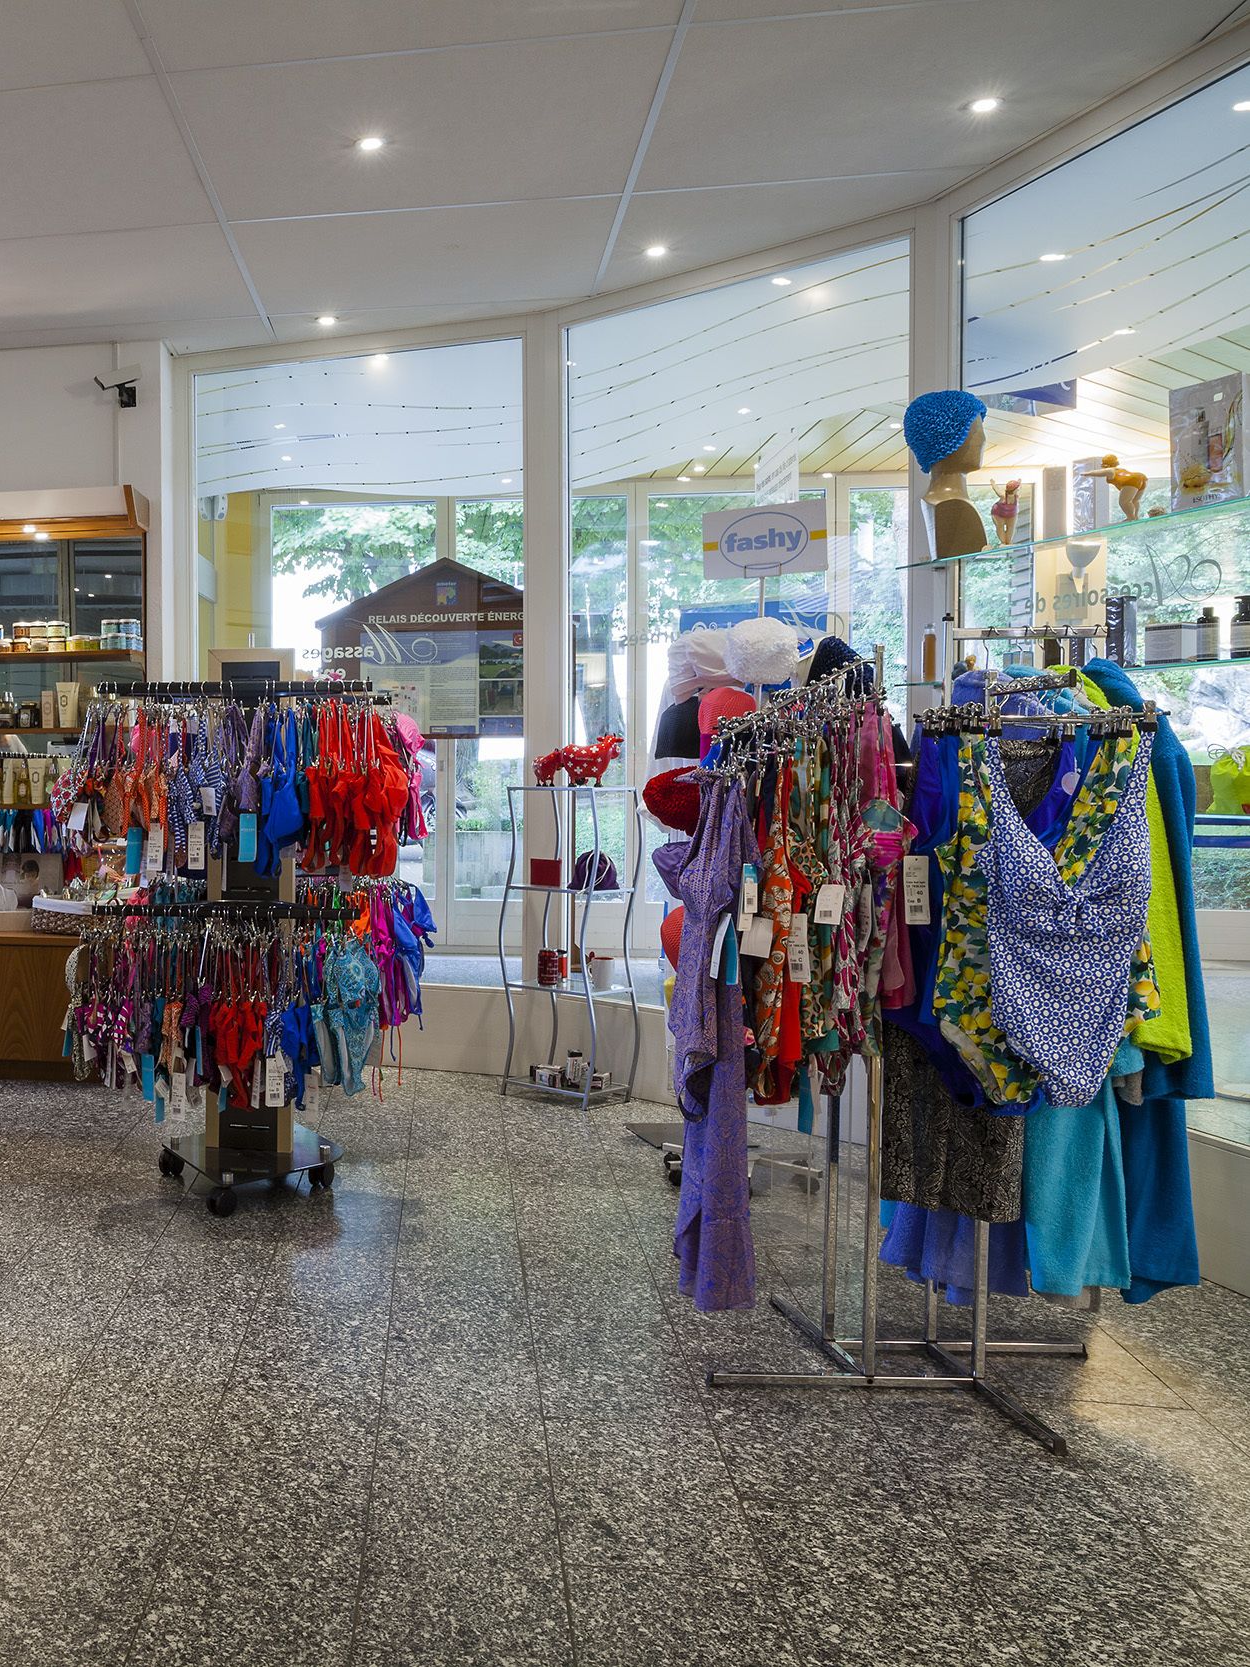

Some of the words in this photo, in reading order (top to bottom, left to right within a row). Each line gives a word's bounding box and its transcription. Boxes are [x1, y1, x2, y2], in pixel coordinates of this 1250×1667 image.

[725, 527, 802, 553] fashy
[369, 614, 407, 624] RELAIS
[410, 612, 485, 623] DÉCOUVERTE
[487, 611, 524, 622] ÉNERG
